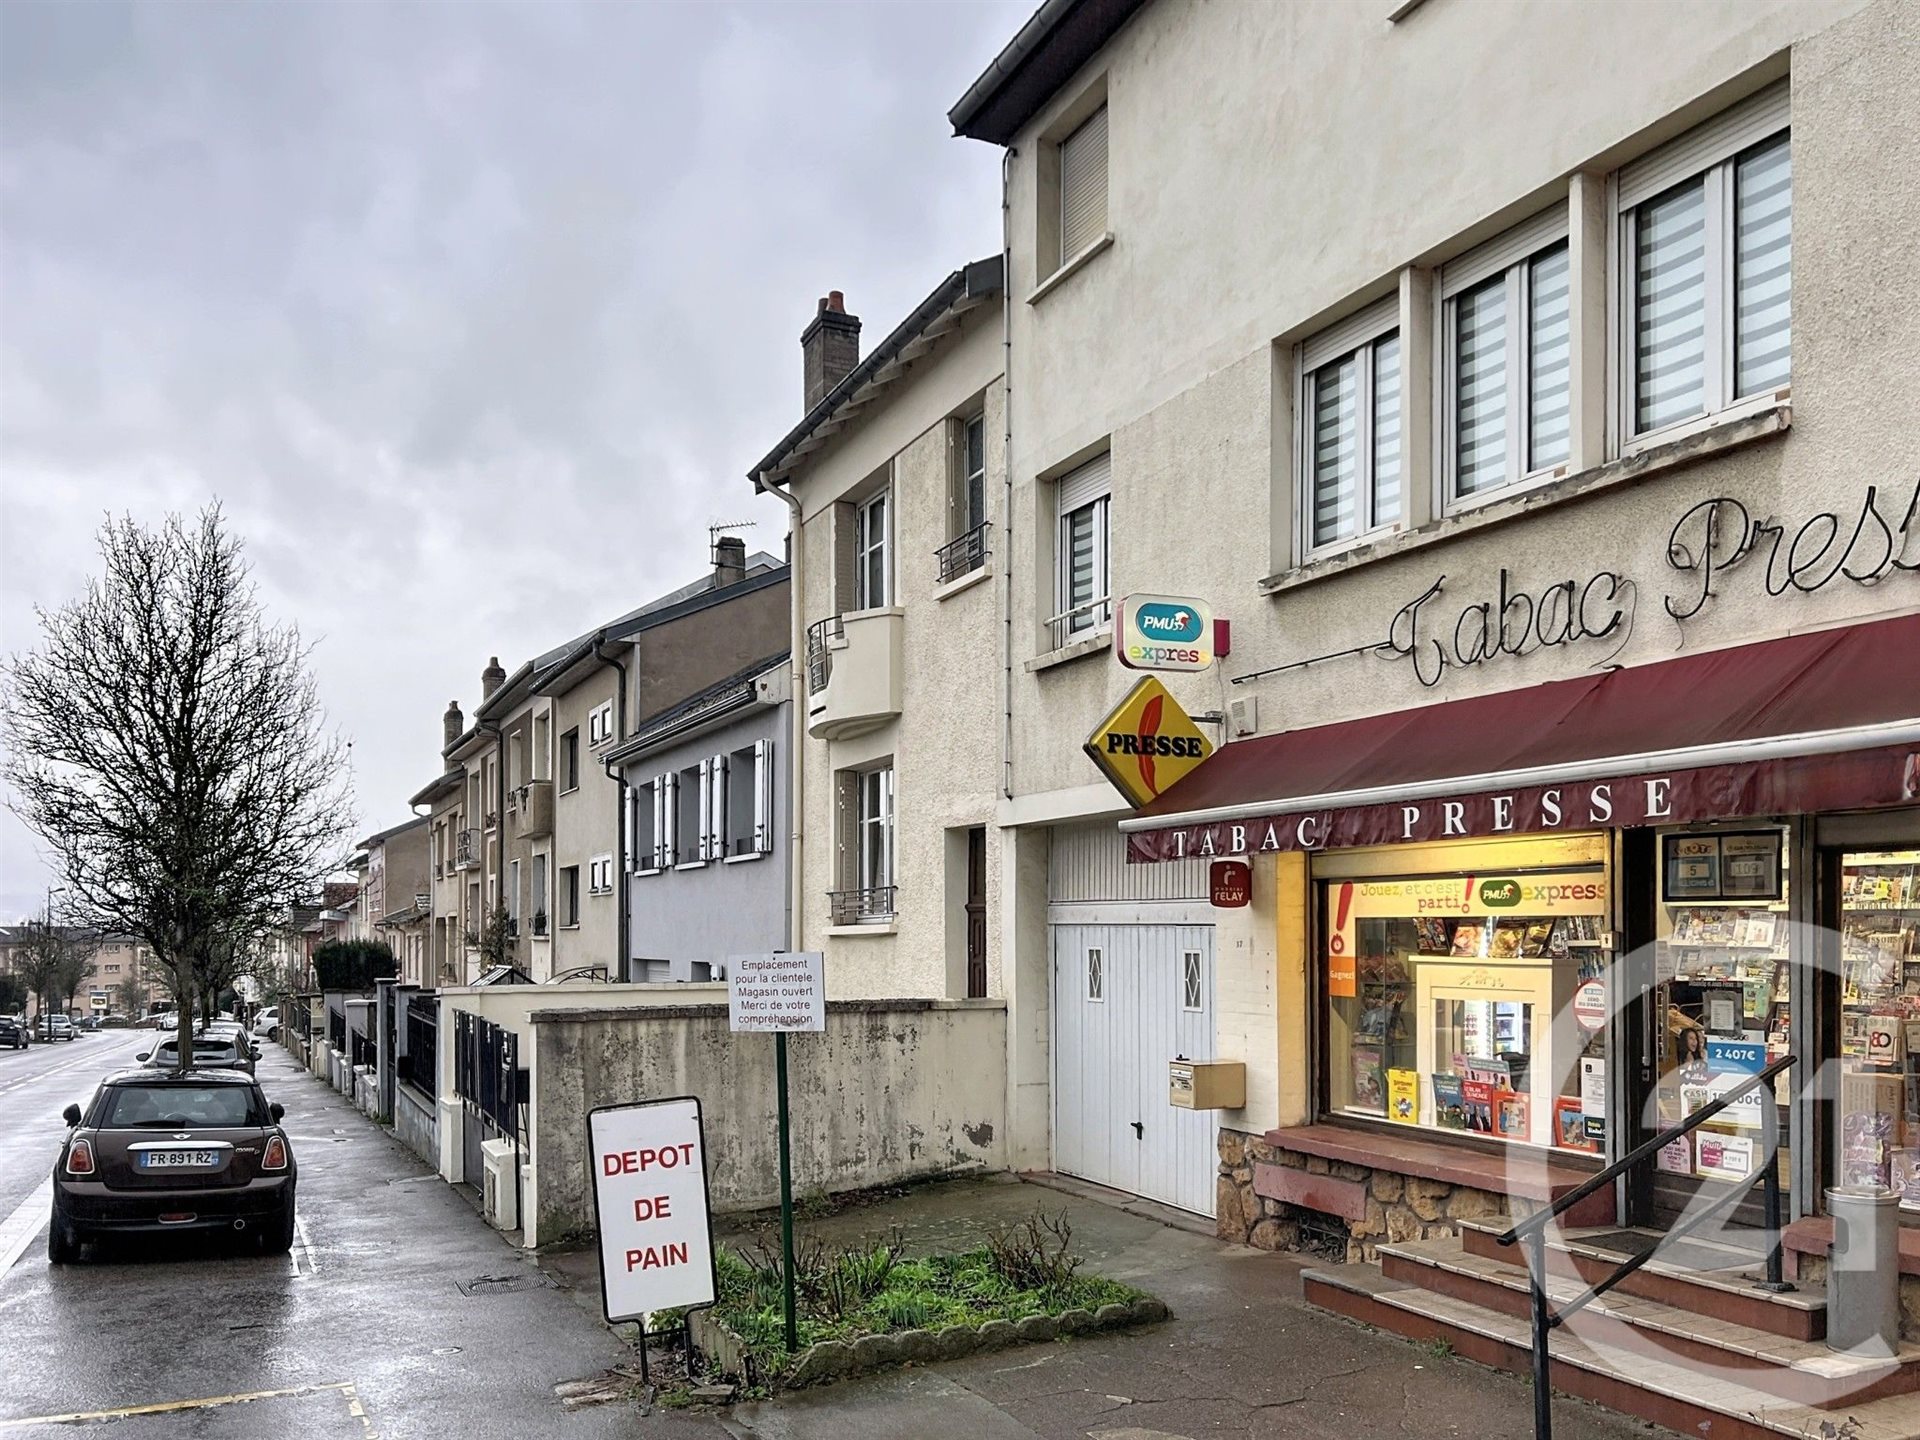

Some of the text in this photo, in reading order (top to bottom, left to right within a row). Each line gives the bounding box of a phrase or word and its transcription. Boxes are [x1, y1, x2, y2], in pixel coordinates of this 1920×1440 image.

[1143, 615, 1175, 630] PMU
[1390, 568, 1624, 687] Tabac
[1129, 645, 1210, 666] express
[1106, 732, 1204, 758] PRESSE
[1172, 778, 1673, 858] TABAC PRESSE
[1361, 881, 1461, 897] Jouez, et c'est
[1483, 889, 1503, 900] PMU
[1418, 895, 1460, 913] parti
[741, 959, 808, 972] Emplacement
[735, 975, 757, 985] pour
[760, 973, 769, 983] la
[738, 986, 813, 999] Magasin ouvert
[741, 1000, 811, 1011] Merci de votre
[1683, 1089, 1708, 1099] CASH
[603, 1143, 695, 1177] DEPOT
[634, 1195, 672, 1222] DE
[625, 1241, 689, 1273] PAIN
